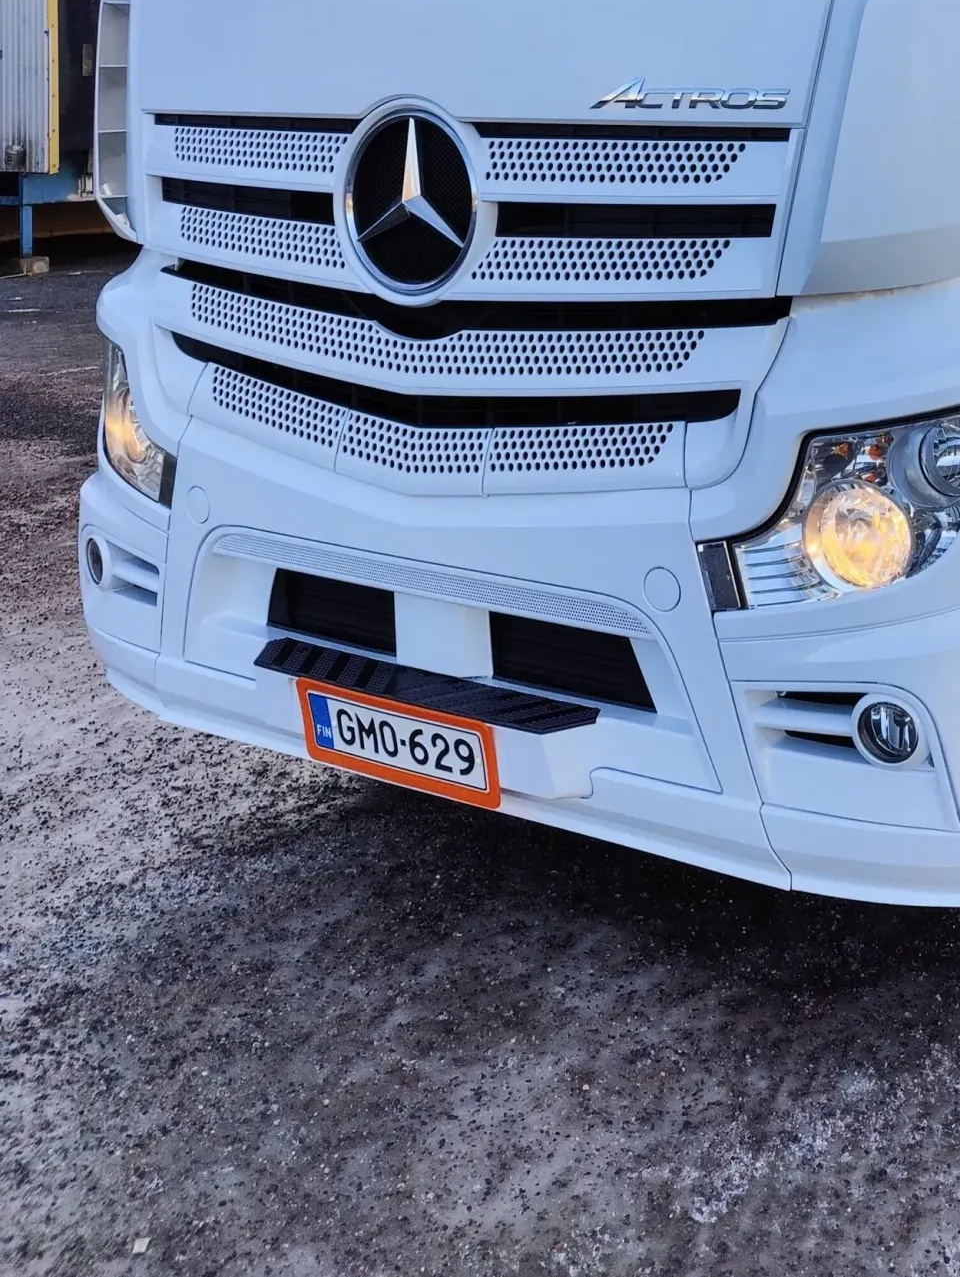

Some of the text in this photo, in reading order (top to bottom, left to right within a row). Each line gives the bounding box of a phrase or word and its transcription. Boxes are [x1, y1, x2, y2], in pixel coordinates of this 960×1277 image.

[589, 76, 791, 110] ACTROS
[316, 724, 332, 740] FIN
[336, 708, 476, 776] GMO-629
